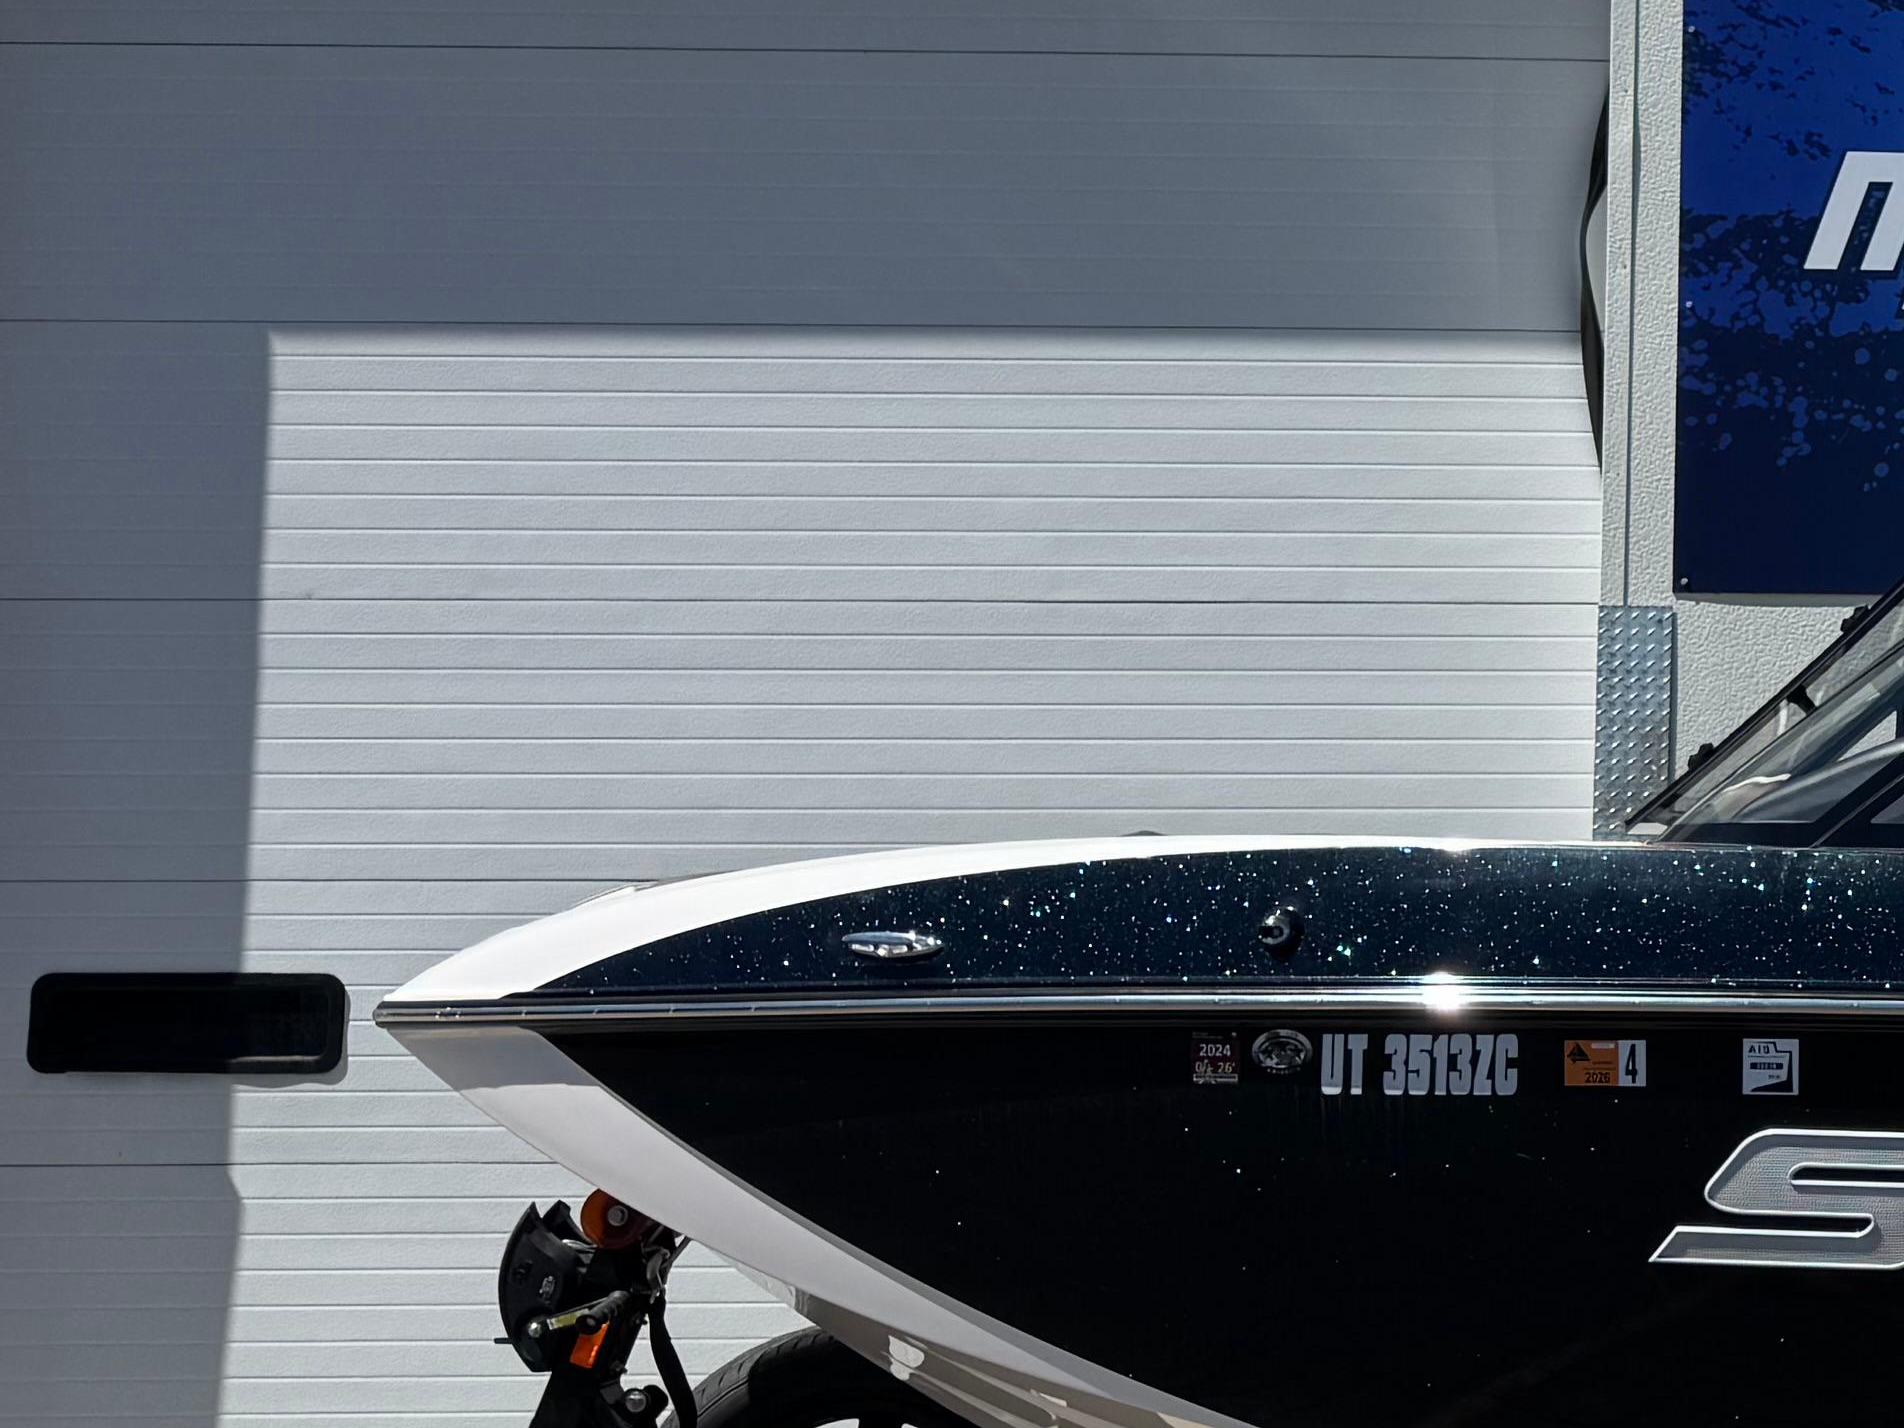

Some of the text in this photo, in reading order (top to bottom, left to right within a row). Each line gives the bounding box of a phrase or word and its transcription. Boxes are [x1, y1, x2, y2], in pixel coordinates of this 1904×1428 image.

[1199, 1043, 1231, 1057] 2024
[1321, 1034, 1368, 1096] UT
[1383, 1034, 1519, 1096] 3513ZC
[1624, 1043, 1638, 1084] 4
